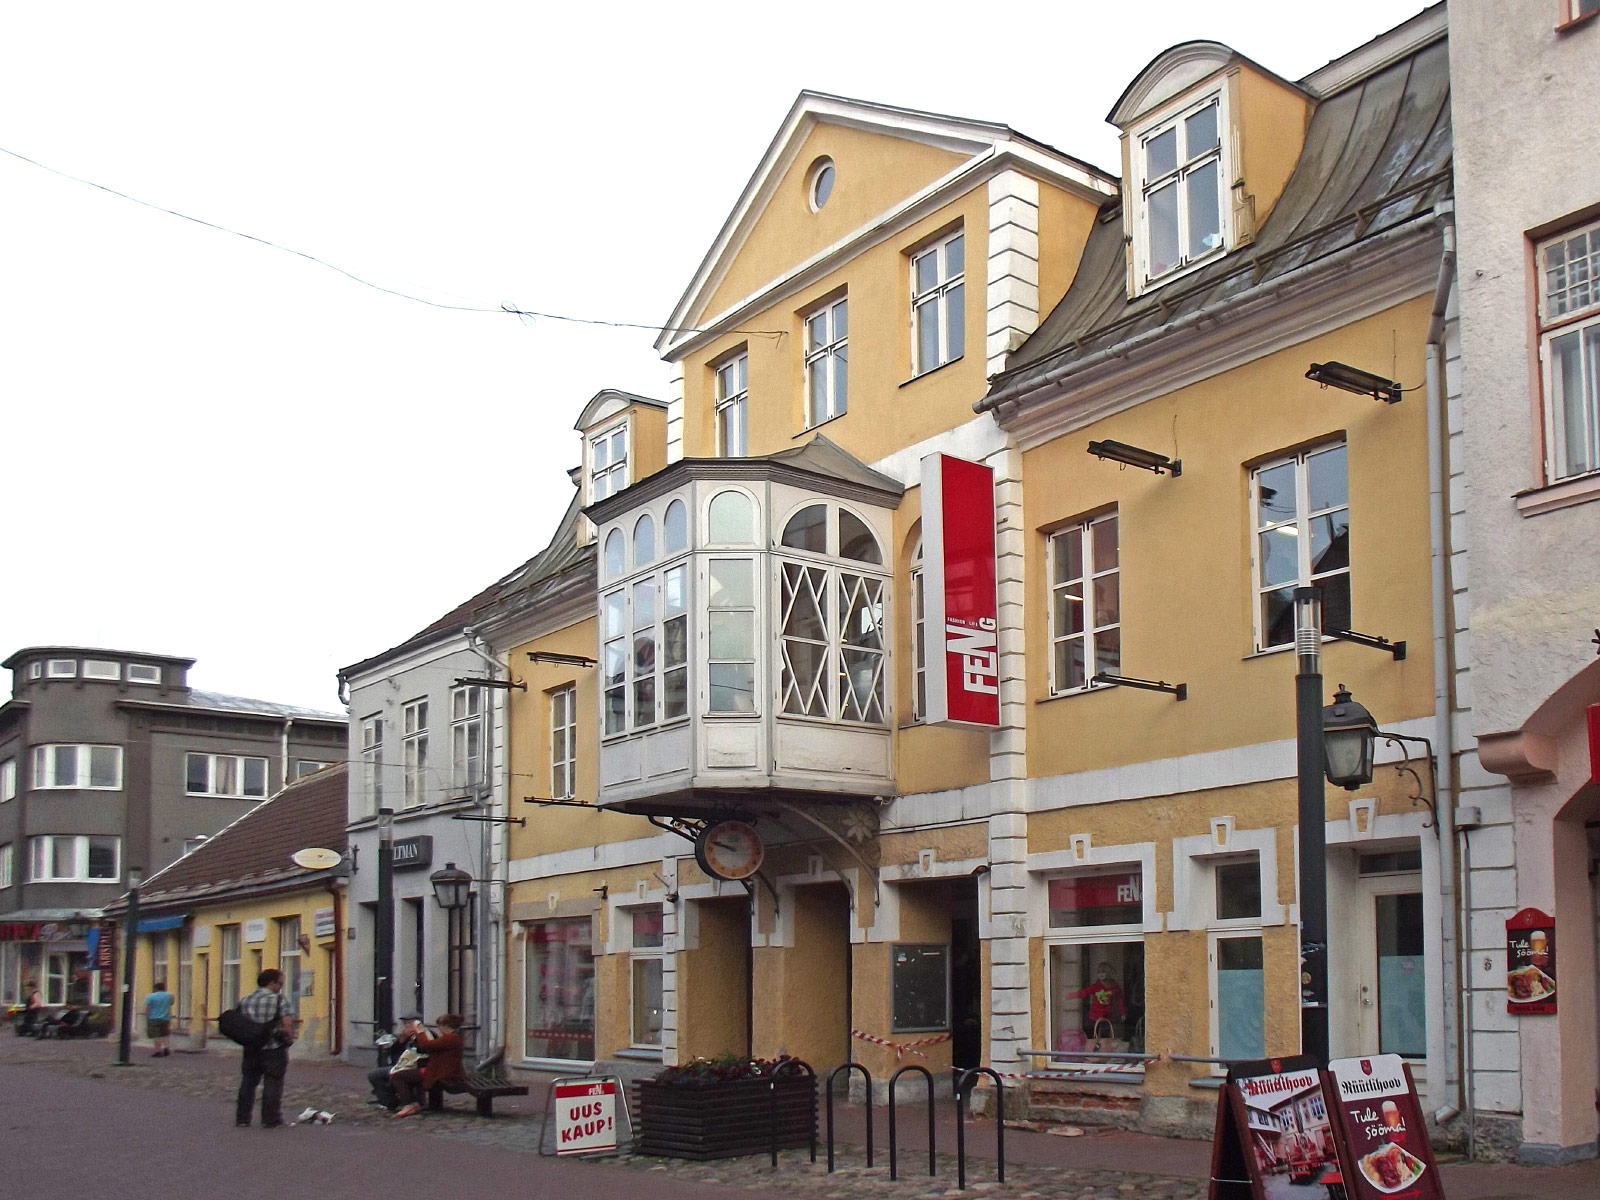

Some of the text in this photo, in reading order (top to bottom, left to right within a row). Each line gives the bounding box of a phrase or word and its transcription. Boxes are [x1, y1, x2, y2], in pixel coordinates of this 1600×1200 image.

[392, 843, 418, 860] LTMAN
[1508, 939, 1530, 949] Tule
[1341, 1077, 1402, 1095] Rüütlihoov
[569, 1101, 603, 1121] UUS
[1349, 1106, 1379, 1124] Tule
[561, 1116, 613, 1143] KAUP!
[1365, 1116, 1406, 1140] sööma!
